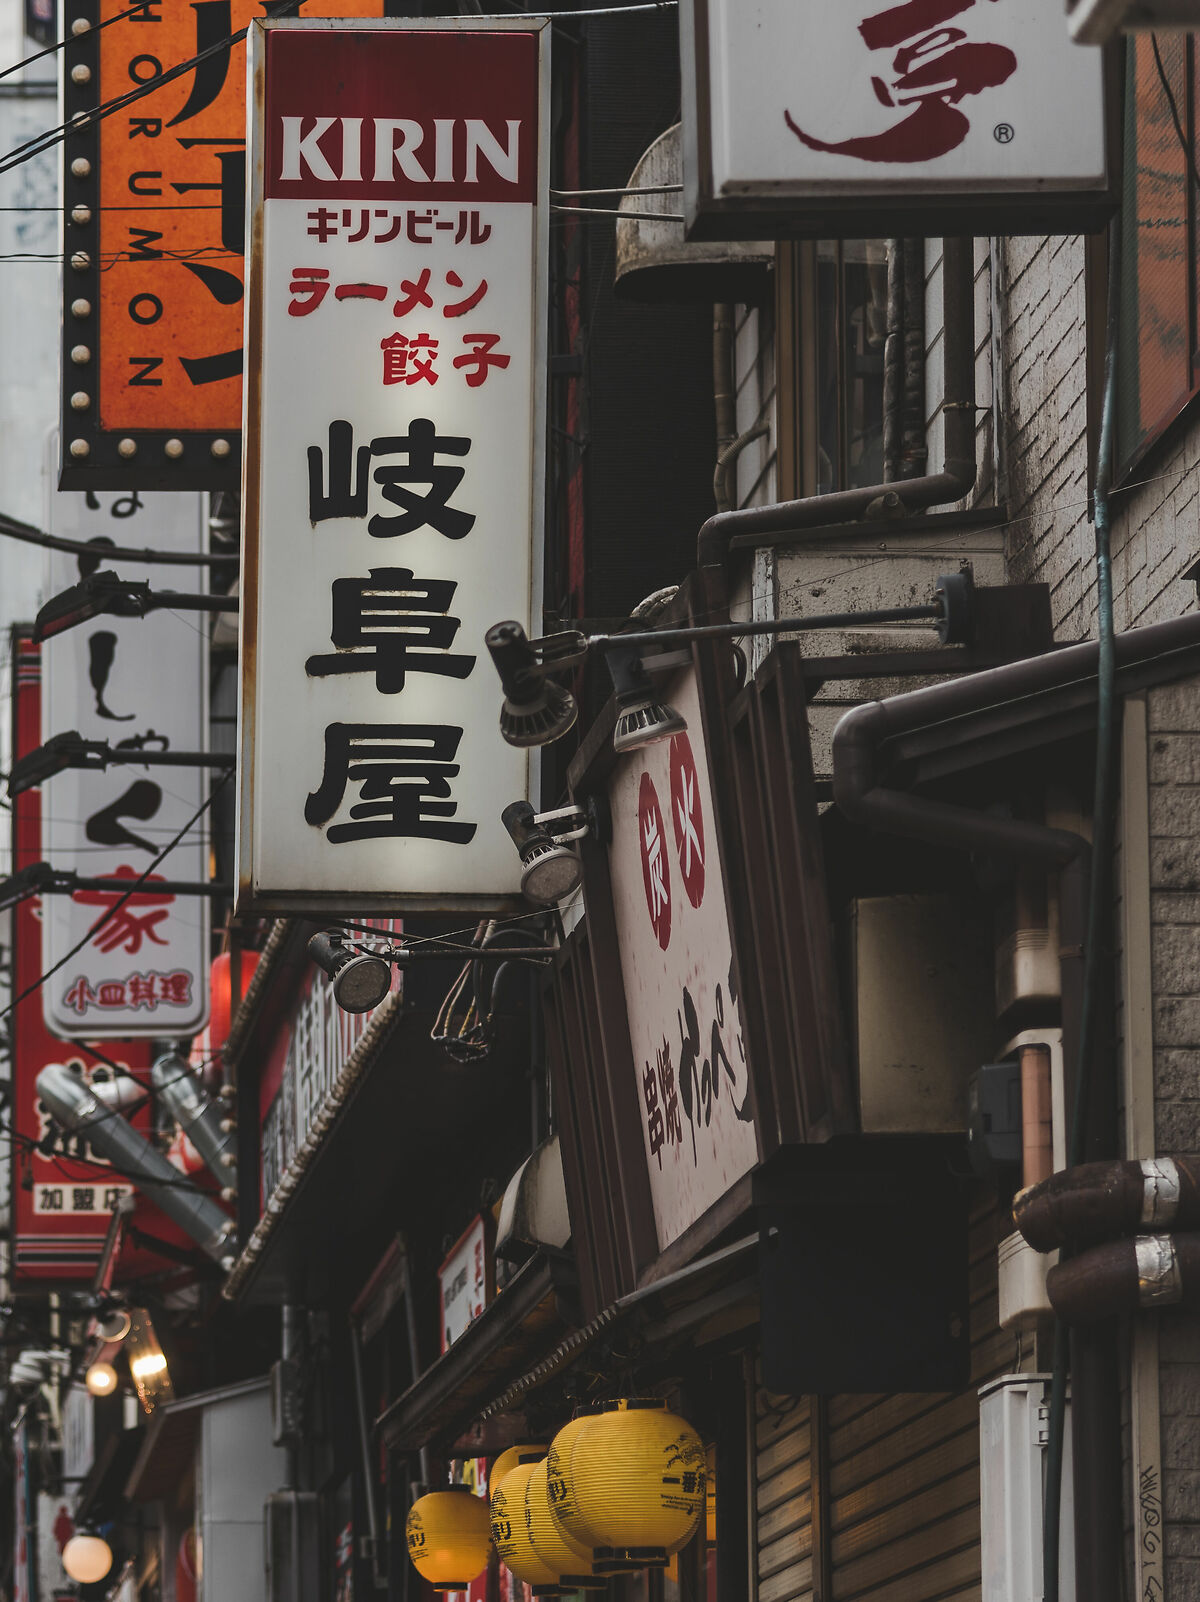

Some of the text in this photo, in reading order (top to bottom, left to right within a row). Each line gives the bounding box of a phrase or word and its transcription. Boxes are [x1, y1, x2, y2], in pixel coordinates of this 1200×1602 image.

[279, 115, 522, 184] KIRIN
[128, 0, 163, 386] HORUMON
[307, 207, 492, 246] キリンビール
[287, 267, 489, 318] ラーメン
[380, 332, 512, 388] 餃子
[304, 417, 478, 846] 岐阜屋
[65, 969, 193, 1014] 小皿料理
